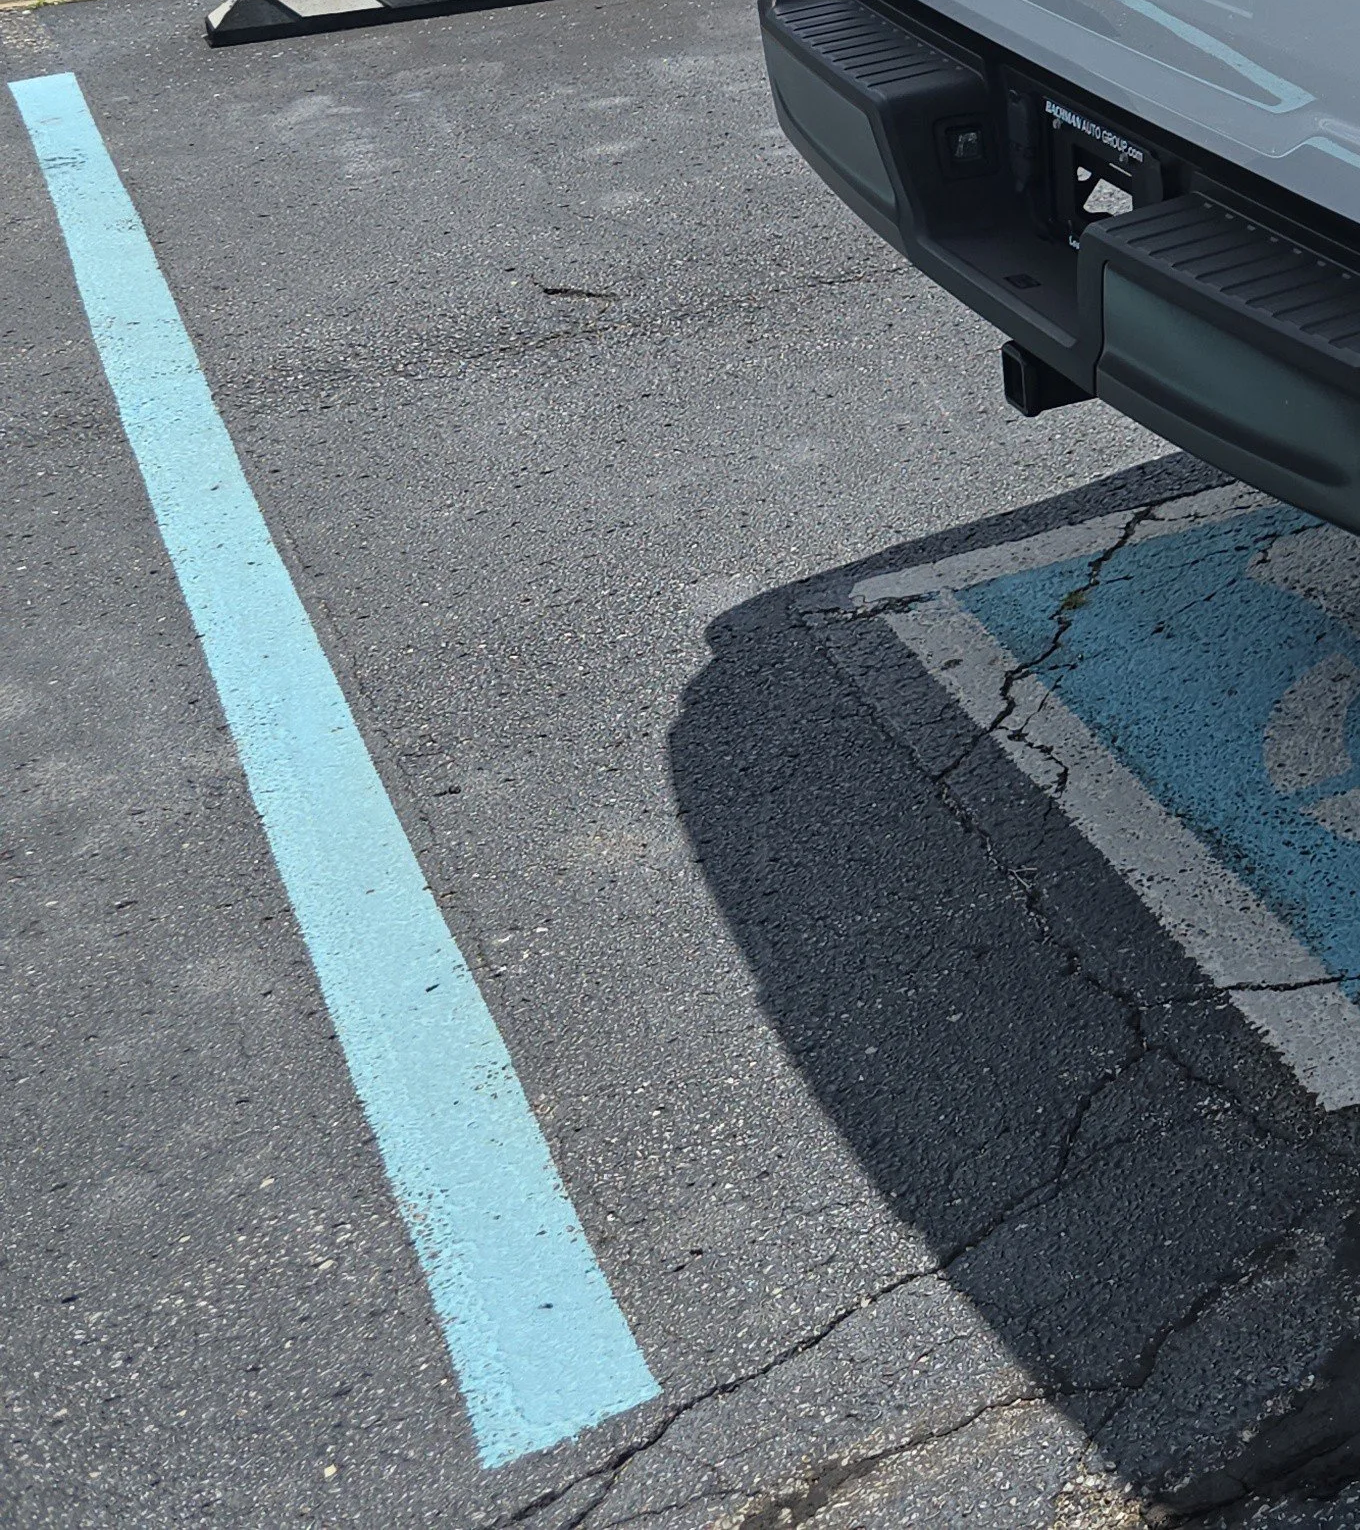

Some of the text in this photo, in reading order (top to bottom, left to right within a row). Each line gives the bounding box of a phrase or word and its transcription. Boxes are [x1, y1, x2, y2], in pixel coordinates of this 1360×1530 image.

[1045, 100, 1144, 163] BACHMAN AUTO GROUP.com
